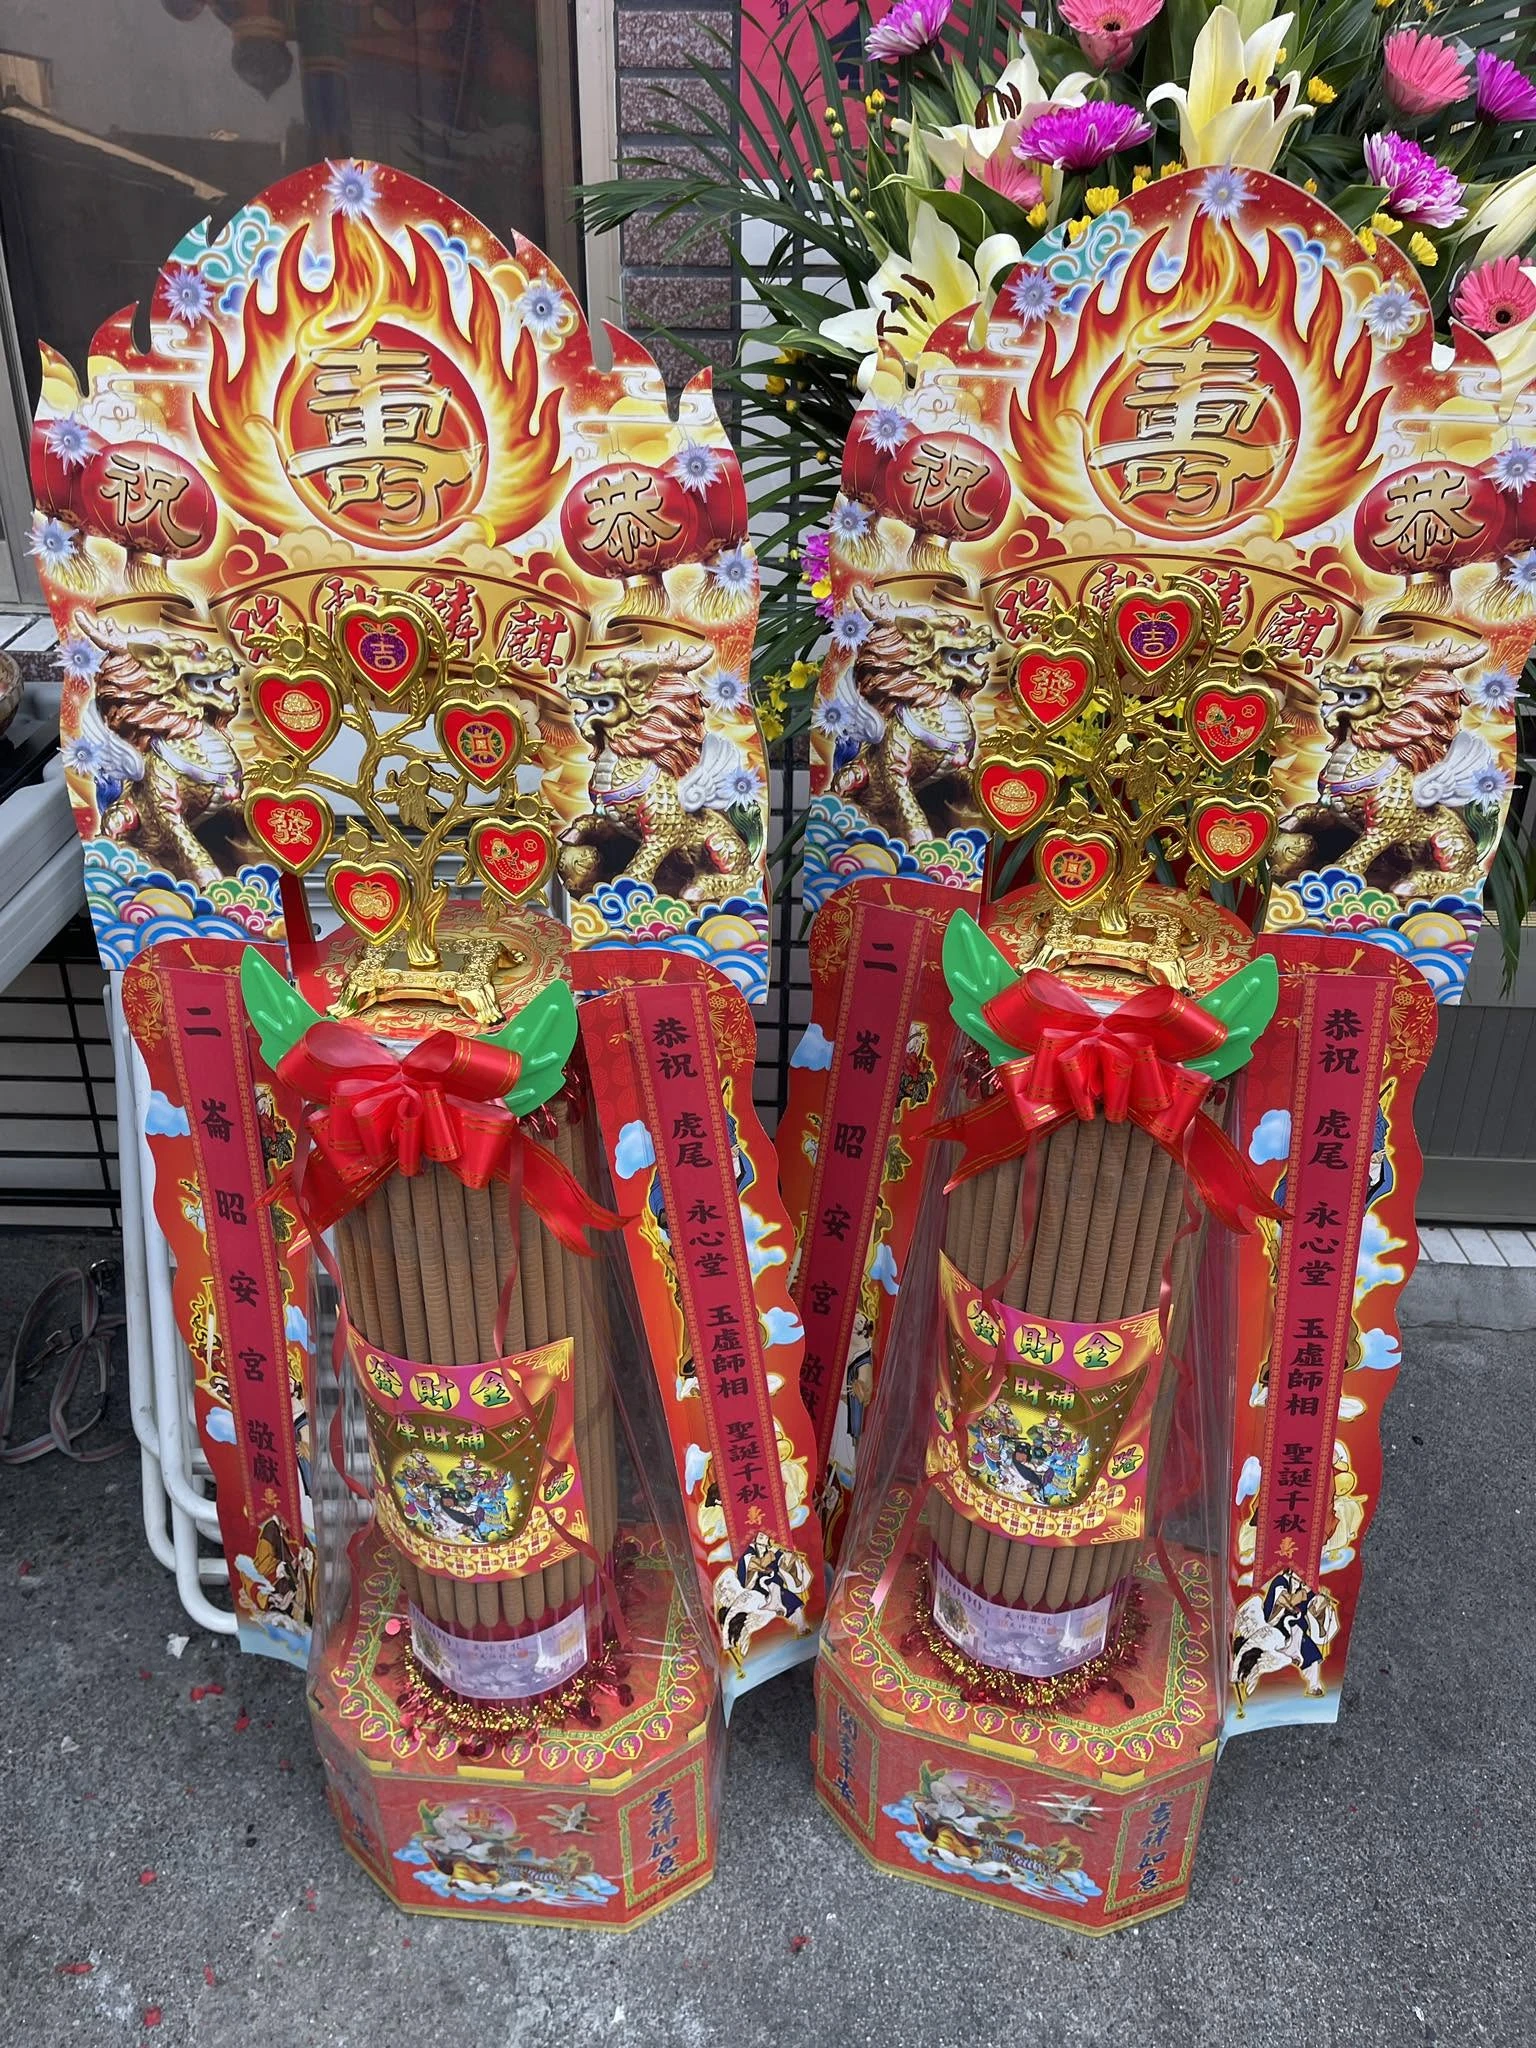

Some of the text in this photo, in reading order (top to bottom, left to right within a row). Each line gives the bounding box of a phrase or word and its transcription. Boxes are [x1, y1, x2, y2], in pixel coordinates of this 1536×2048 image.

[285, 337, 476, 539] 壽
[1088, 336, 1285, 535] 壽
[99, 454, 205, 546] 祝
[580, 469, 687, 564] 恭
[899, 442, 993, 532] 祝
[1375, 472, 1485, 558] 恭
[371, 642, 397, 669] 吉
[1029, 666, 1077, 706] 發
[1141, 629, 1168, 656] 吉
[268, 808, 313, 846] 發
[648, 1788, 682, 1880] 吉祥如意
[1131, 1801, 1173, 1893] 吉祥如意
